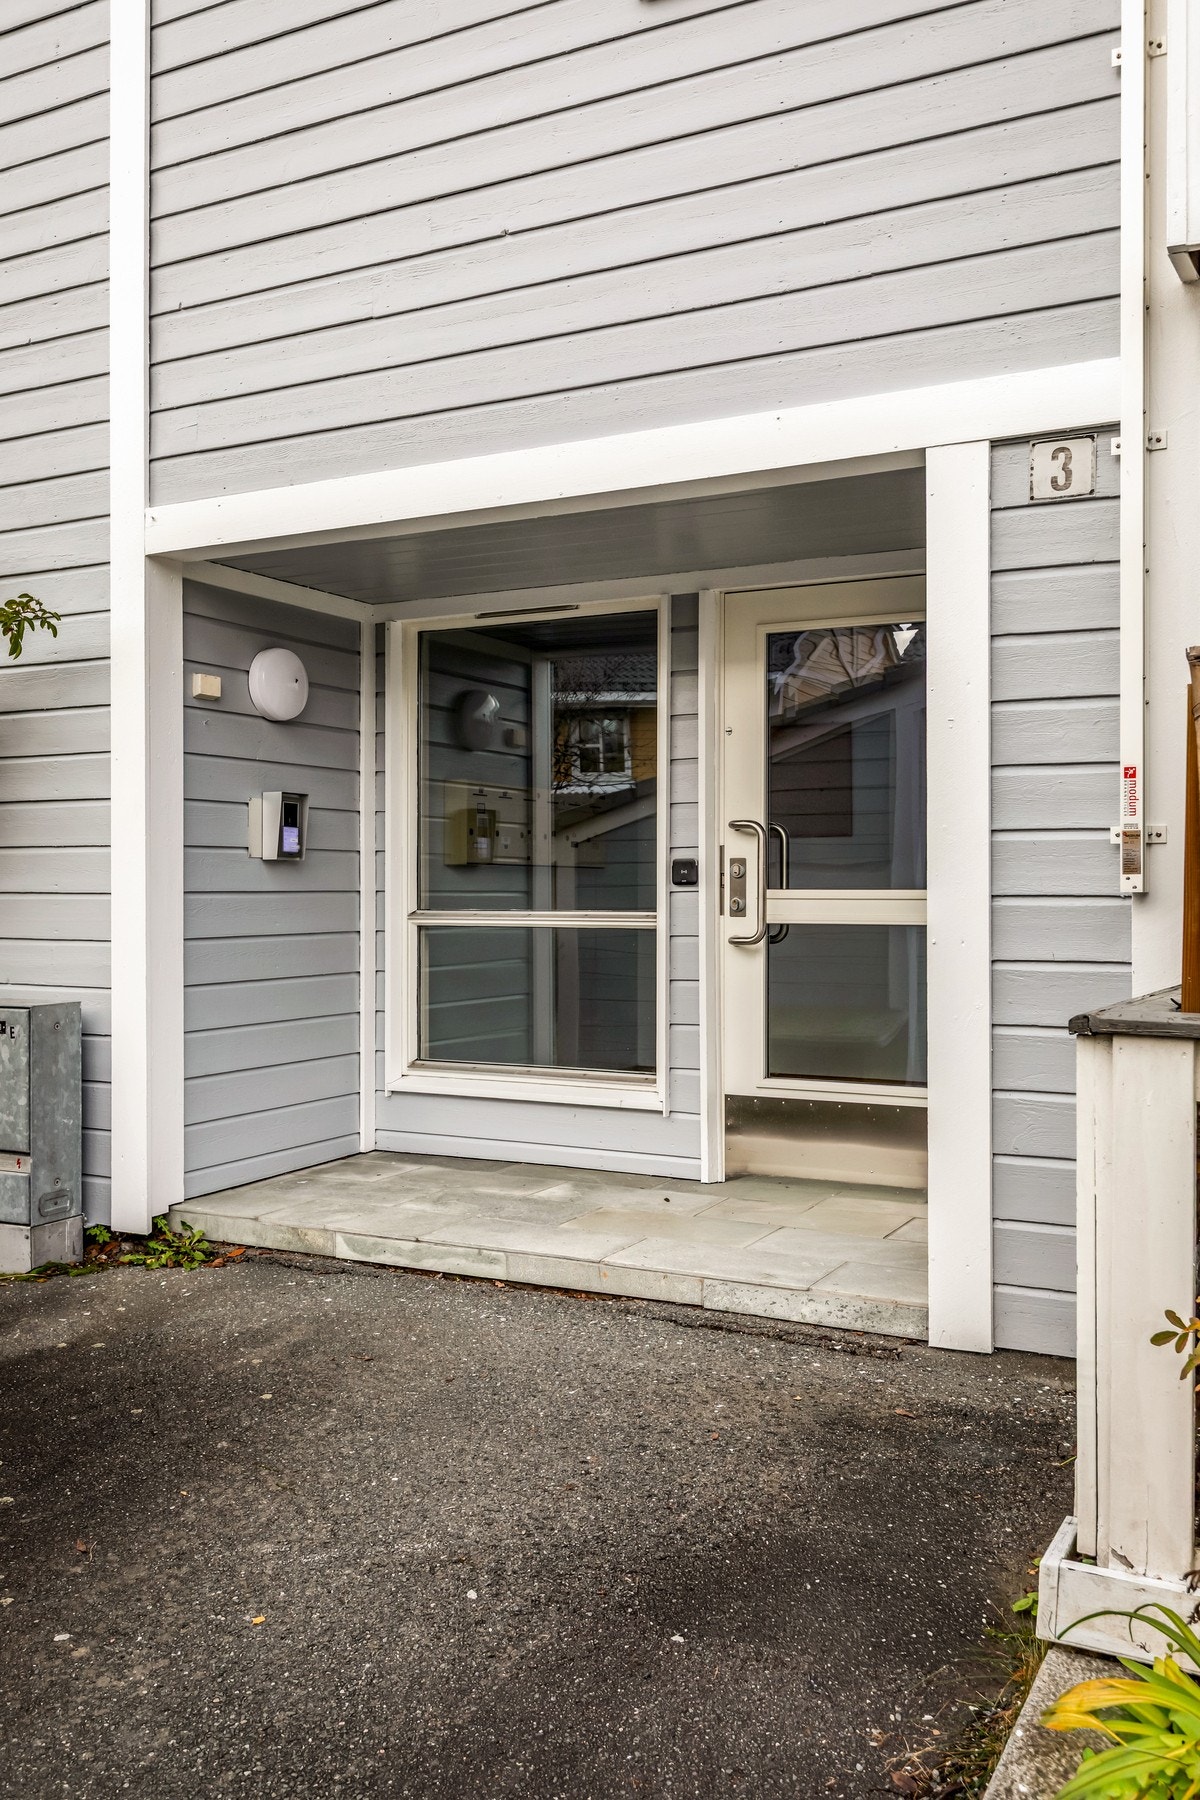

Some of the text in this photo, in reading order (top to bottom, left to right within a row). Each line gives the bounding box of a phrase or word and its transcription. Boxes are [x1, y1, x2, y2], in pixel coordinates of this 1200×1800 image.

[1051, 446, 1072, 491] 3
[1129, 780, 1139, 816] modum
[10, 1026, 15, 1039] E
